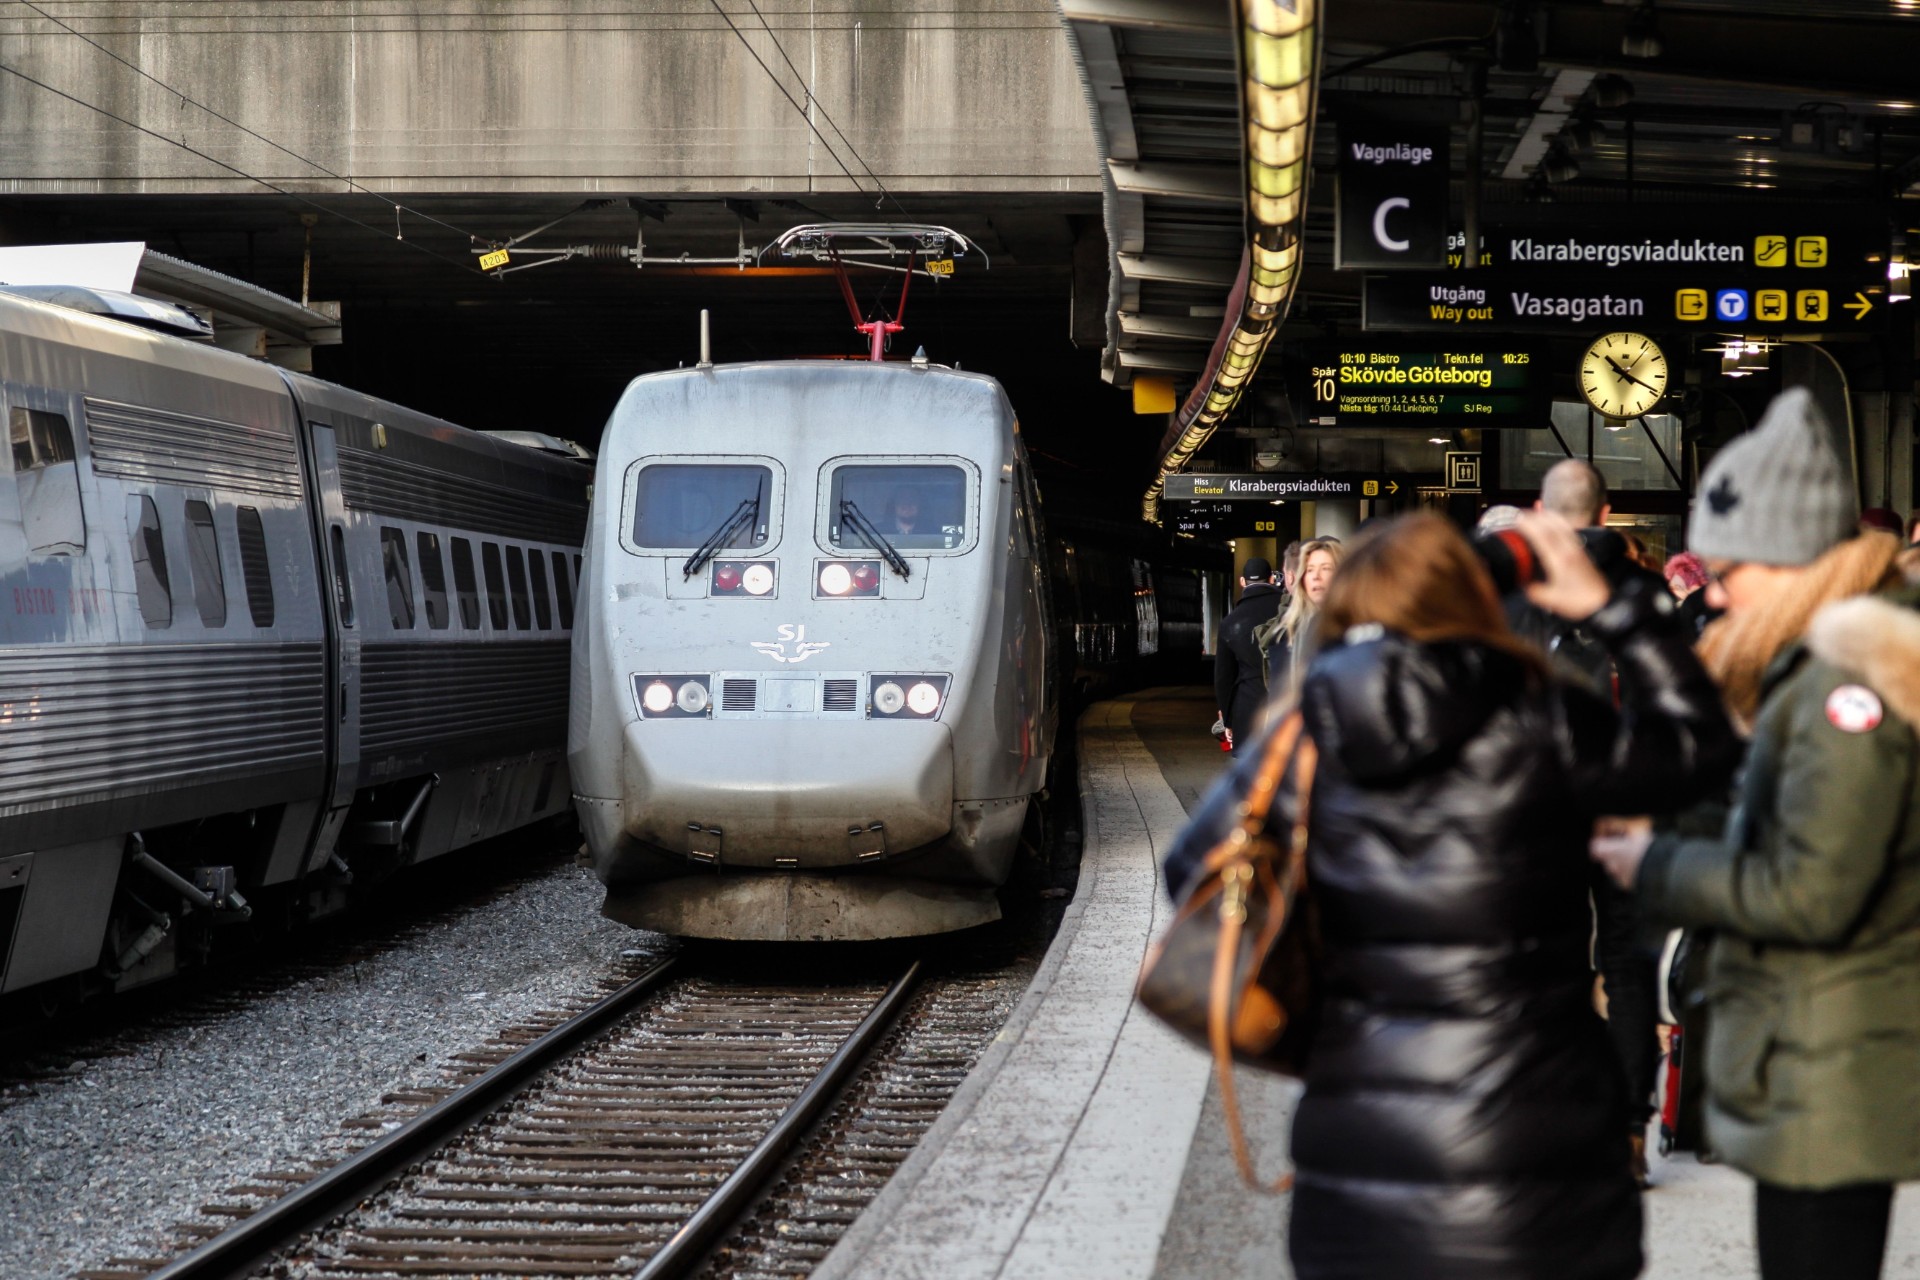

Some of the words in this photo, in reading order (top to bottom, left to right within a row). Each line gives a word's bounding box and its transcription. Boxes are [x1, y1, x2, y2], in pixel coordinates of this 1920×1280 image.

[1352, 142, 1433, 165] Vagnläge
[1372, 196, 1411, 252] C
[483, 252, 507, 268] A203
[1510, 238, 1745, 267] Klarabergsviadukten
[1430, 285, 1486, 304] Utgång
[1430, 304, 1463, 323] Way
[1466, 304, 1494, 320] out
[1511, 291, 1645, 322] Vasagatan
[1340, 353, 1366, 364] 10:10
[1370, 353, 1400, 364] Bistro
[1443, 353, 1484, 364] Tekn.fel
[1502, 353, 1530, 364] 10:25
[1312, 367, 1337, 378] Spår
[1340, 366, 1407, 383] Skövde
[1408, 366, 1492, 388] Göteborg
[1313, 379, 1336, 401] 10
[1340, 395, 1391, 405] Vagnsordning
[1340, 404, 1362, 413] Nästa
[1403, 404, 1439, 414] Linköping
[1464, 404, 1475, 413] SJ
[1476, 404, 1492, 414] Reg
[1194, 478, 1209, 486] Hiss
[1194, 486, 1224, 494] Elevator
[1229, 479, 1351, 495] Klarabergsviadukten
[13, 586, 56, 615] BISTRO
[777, 623, 805, 643] SJ
